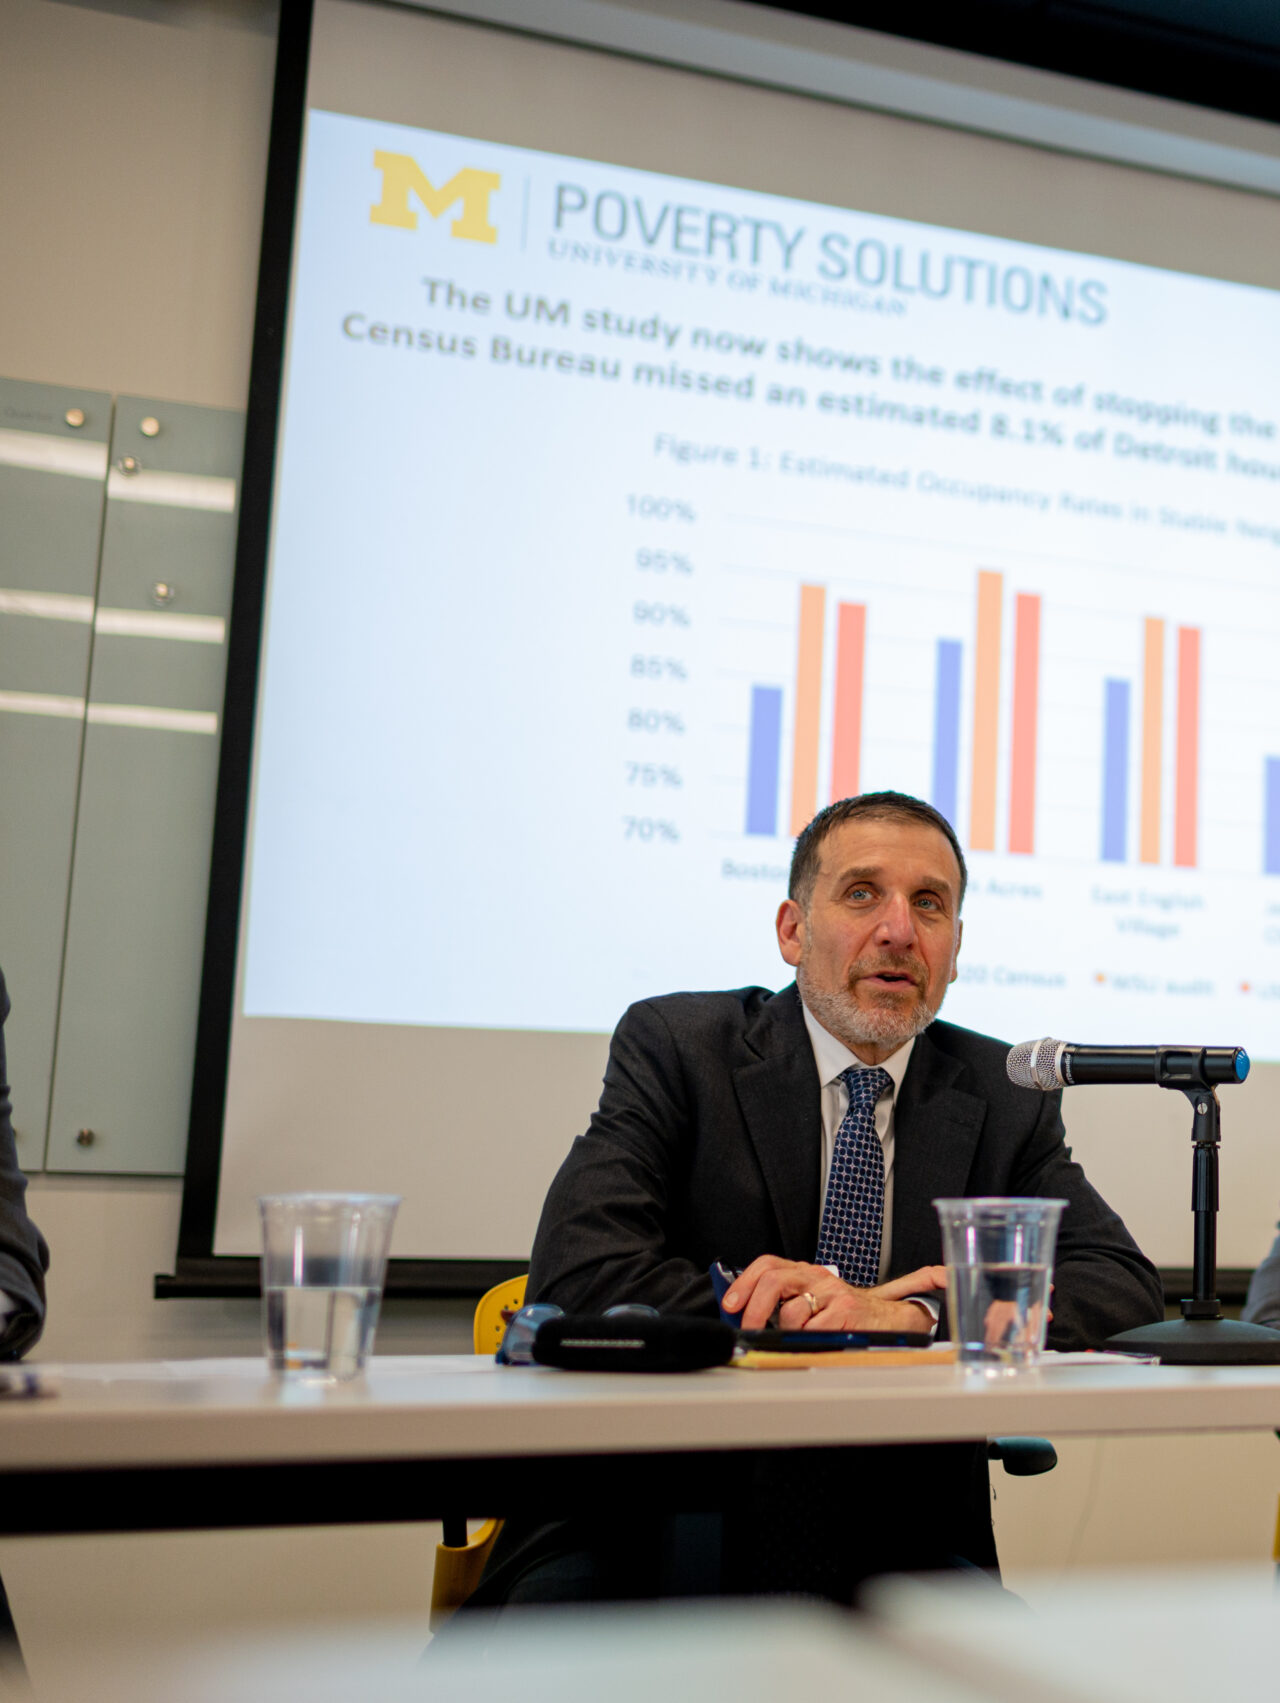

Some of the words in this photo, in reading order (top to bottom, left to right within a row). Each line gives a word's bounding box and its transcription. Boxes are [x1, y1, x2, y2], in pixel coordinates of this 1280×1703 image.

[368, 148, 502, 246] M
[553, 181, 806, 271] POVERTY
[816, 230, 1109, 328] SOLUTIONS
[548, 236, 718, 287] UNIVERSITY
[725, 270, 760, 293] OF
[768, 275, 908, 317] MICHIGAN
[422, 276, 492, 314] The
[503, 292, 571, 328] UM
[582, 306, 684, 349] study
[691, 325, 766, 358] now
[775, 338, 881, 377] shows
[890, 355, 945, 386] the
[954, 365, 1045, 403] effect
[1051, 382, 1086, 408] of
[1093, 391, 1222, 437] stopping
[1228, 410, 1276, 441] the
[341, 311, 479, 360] Census
[490, 335, 622, 381] Bureau
[632, 358, 757, 402] missed
[765, 381, 808, 407] an
[817, 388, 983, 436] estimated
[989, 411, 1065, 449] 8.1%
[1073, 427, 1106, 452] of
[1113, 430, 1220, 472] Detroit
[653, 431, 739, 468] Figure
[748, 445, 772, 471] 1:
[778, 450, 912, 490] Estimated
[915, 470, 1052, 513] Occupancy
[626, 492, 697, 524] 100%
[634, 546, 695, 577] 95%
[631, 599, 692, 631] 90%
[630, 652, 690, 682] 85%
[626, 706, 687, 738] 80%
[624, 760, 685, 791] 75%
[621, 814, 682, 847] 70%
